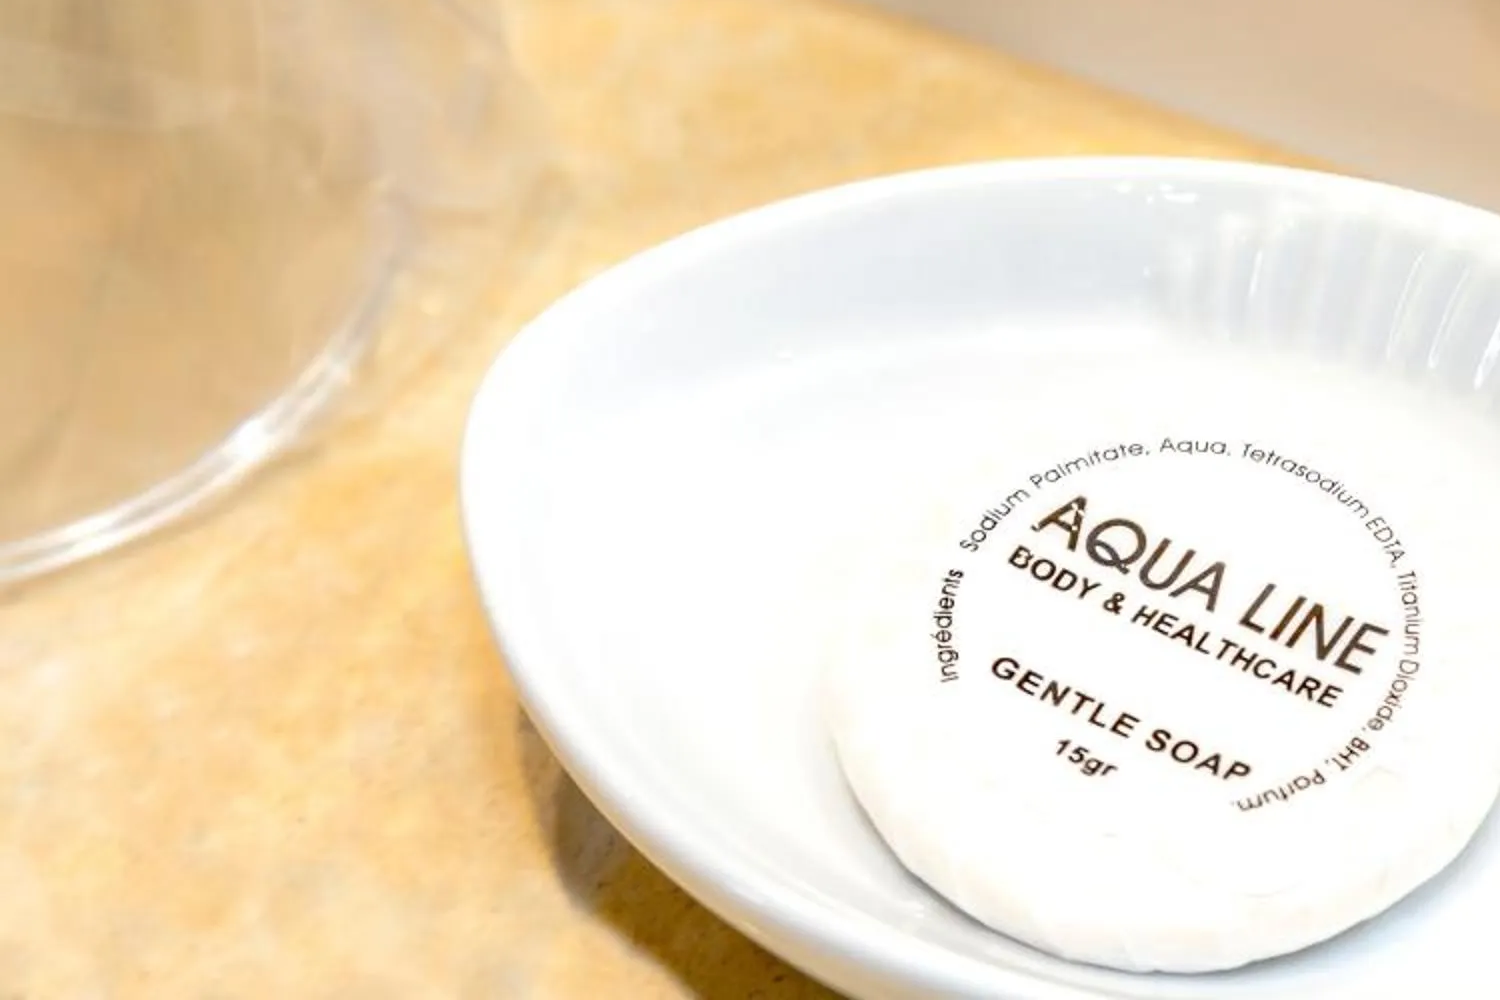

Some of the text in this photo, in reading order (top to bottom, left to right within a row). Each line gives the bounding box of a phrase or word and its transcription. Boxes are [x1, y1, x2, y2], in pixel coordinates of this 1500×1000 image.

[930, 568, 964, 683] Ingrédients
[959, 489, 1031, 552] Sodium
[1241, 442, 1370, 519] Tetrasodium
[1397, 570, 1421, 656] Titanium
[1008, 545, 1344, 708] BODY & HEALTHCARE
[1030, 495, 1390, 675] AQUA LINE
[990, 656, 1251, 783] GENTLE SOAP
[1056, 737, 1118, 778] 15gr
